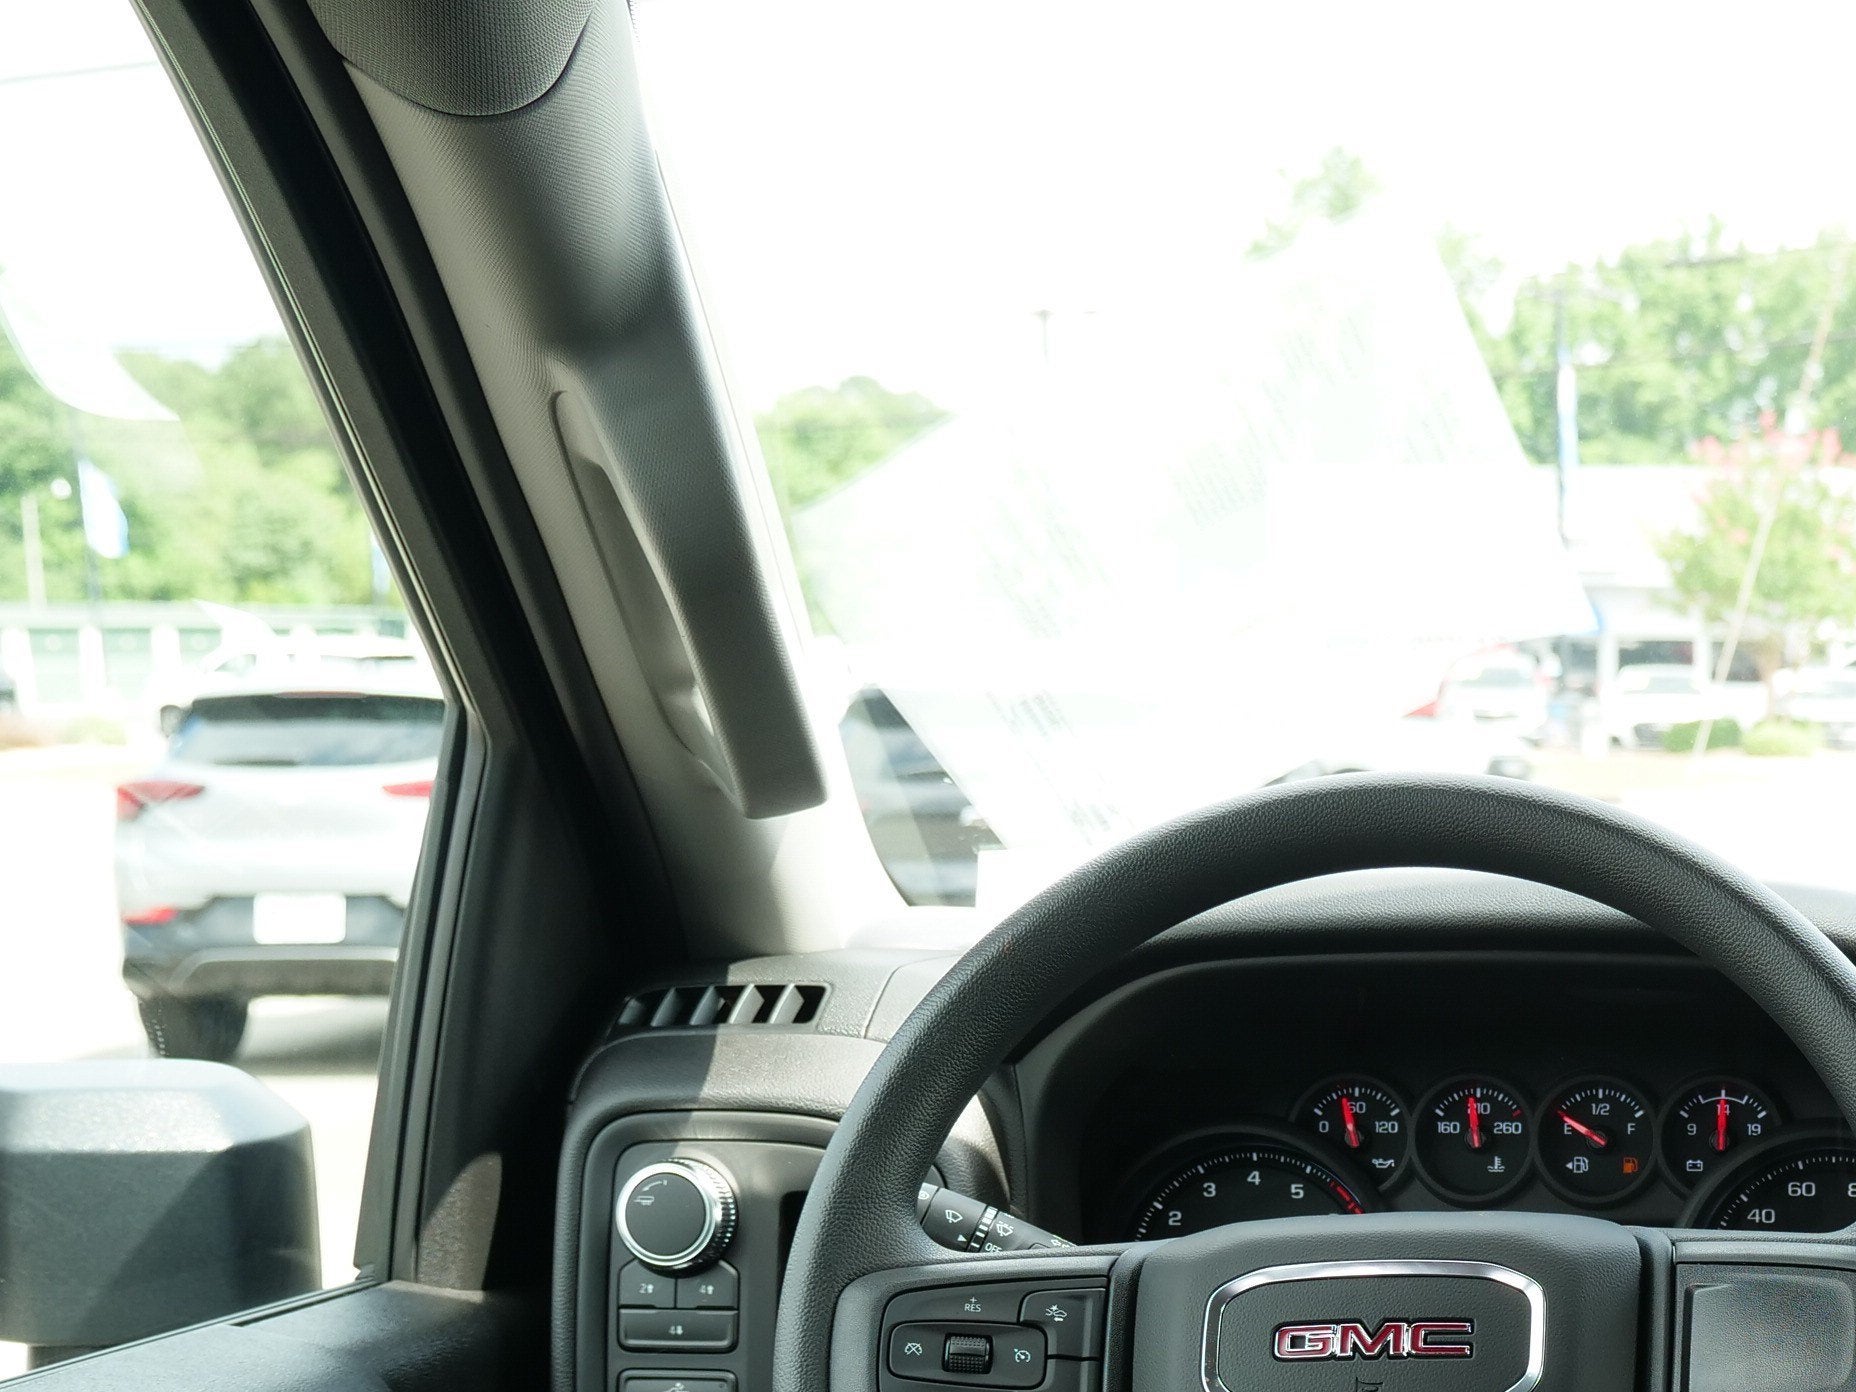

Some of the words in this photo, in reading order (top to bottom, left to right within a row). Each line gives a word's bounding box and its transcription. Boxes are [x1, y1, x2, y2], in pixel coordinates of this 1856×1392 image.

[1346, 1101, 1366, 1114] 60
[1591, 1103, 1610, 1116] 1/2
[1318, 1121, 1330, 1133] 0
[1375, 1121, 1398, 1134] 120
[1437, 1121, 1460, 1134] 160
[1493, 1121, 1522, 1134] 260
[1564, 1122, 1572, 1135] E
[1627, 1123, 1636, 1135] F
[1687, 1123, 1697, 1136] 9
[1746, 1123, 1761, 1136] 19
[1247, 1170, 1261, 1185] 4
[1203, 1182, 1216, 1198] 3
[1290, 1184, 1305, 1199] 5
[1787, 1181, 1816, 1198] 60
[1168, 1210, 1182, 1226] 2
[1747, 1208, 1776, 1224] 40
[964, 1302, 982, 1313] RES
[1274, 1321, 1473, 1359] GMC
